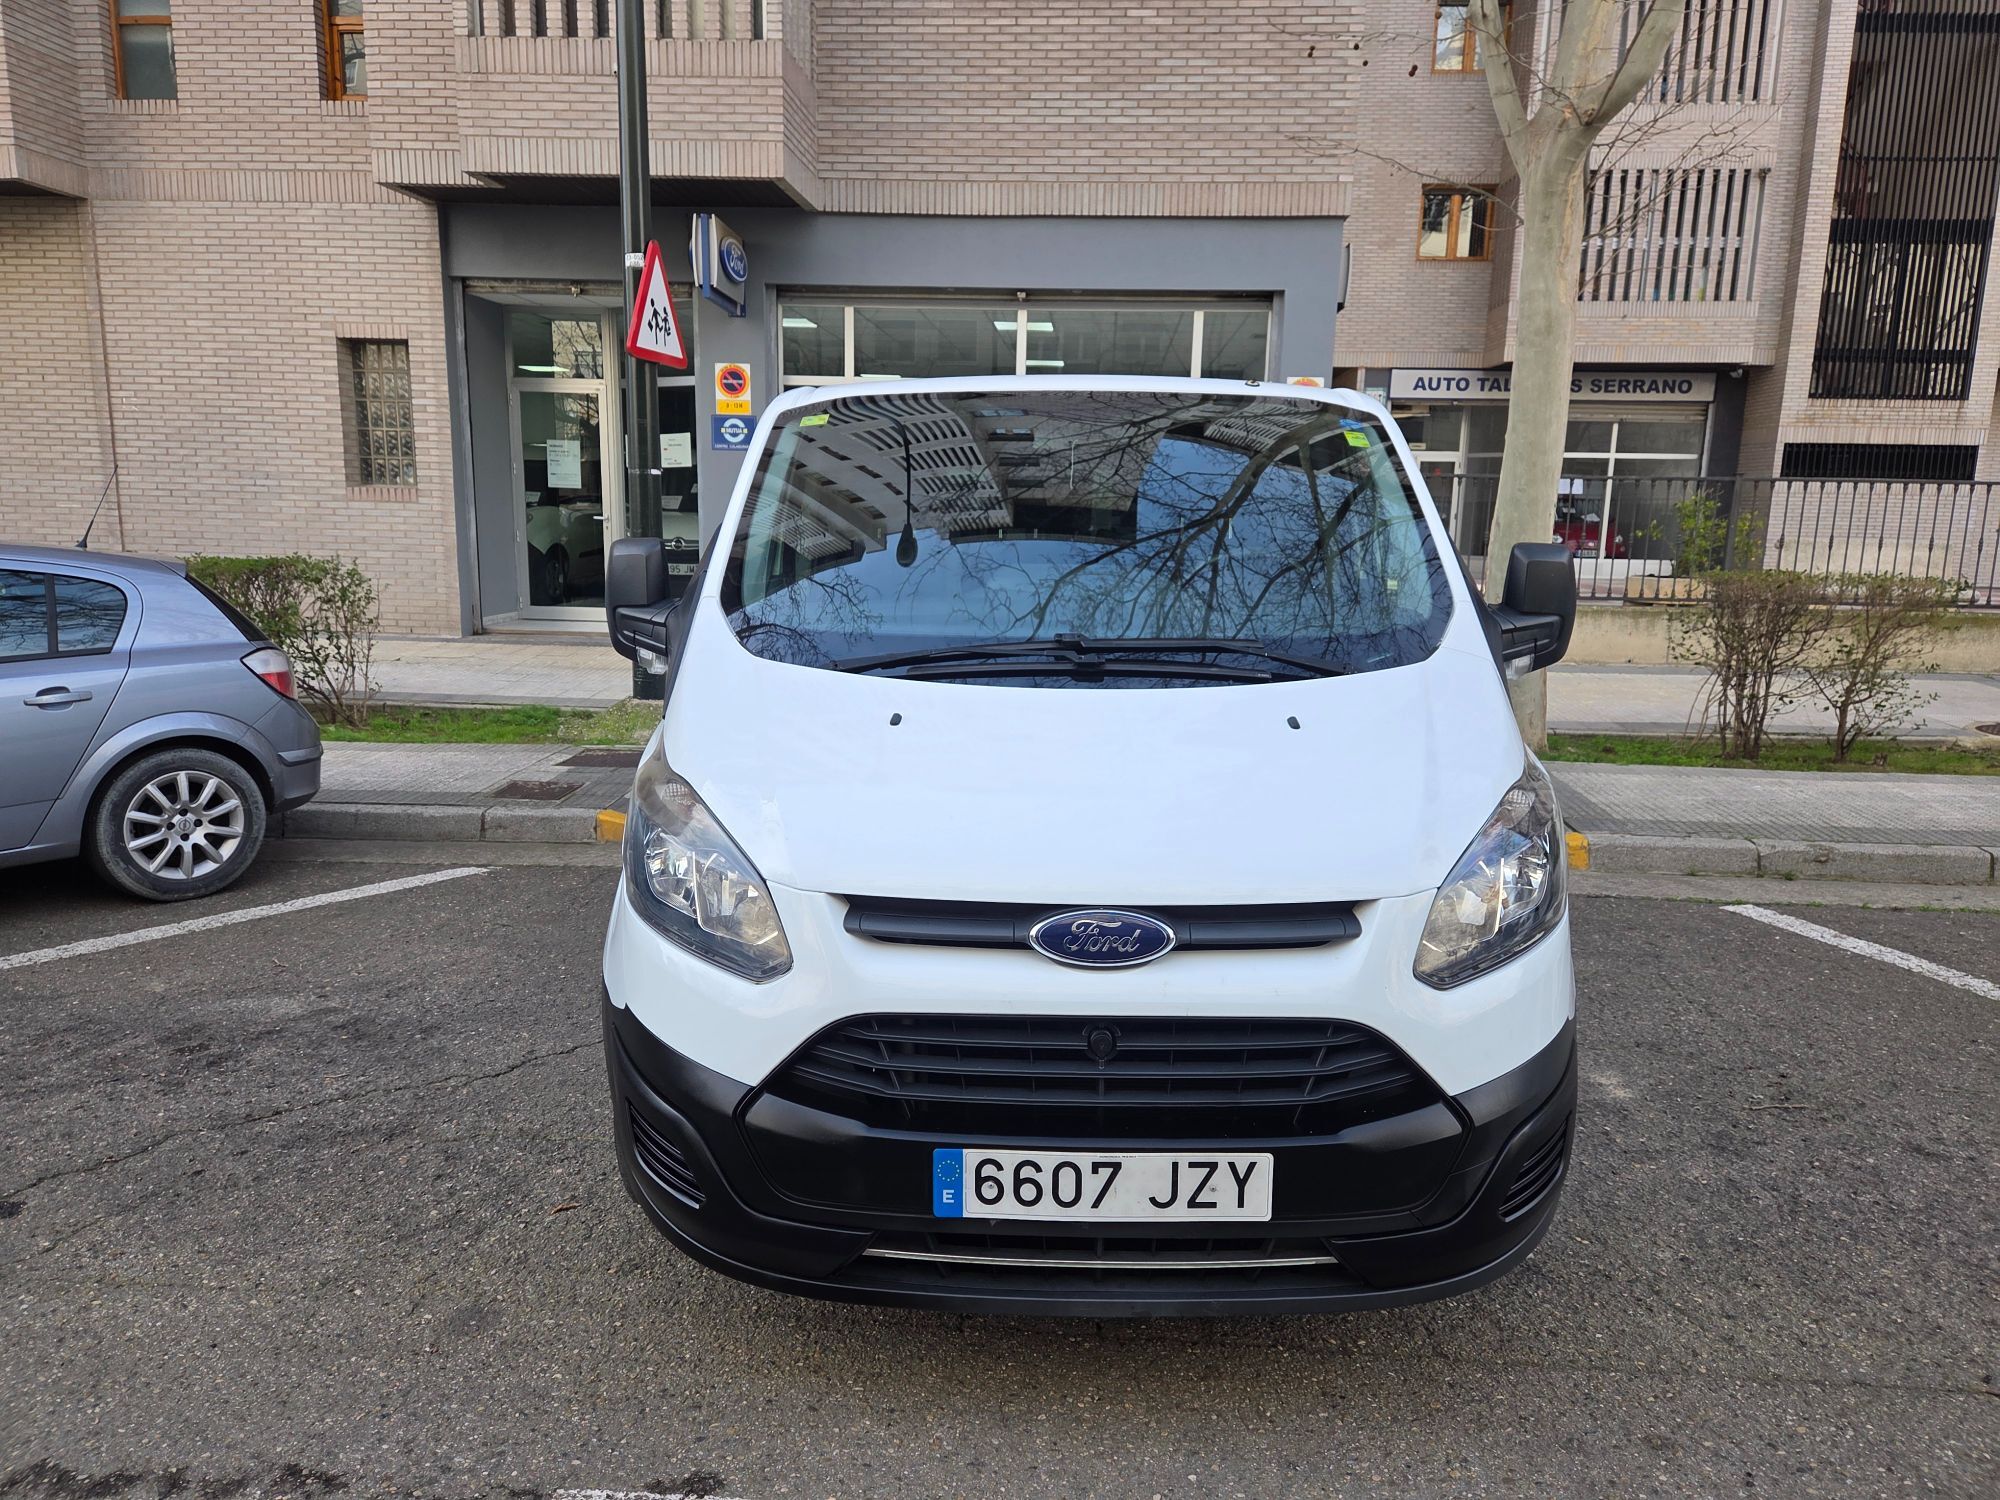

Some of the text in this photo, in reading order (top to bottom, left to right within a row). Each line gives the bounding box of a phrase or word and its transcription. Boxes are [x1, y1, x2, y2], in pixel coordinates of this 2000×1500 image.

[730, 244, 745, 275] Ford
[1413, 376, 1693, 394] AUTO TALS SERRANO
[1063, 919, 1142, 952] Ford
[942, 1189, 954, 1203] E
[974, 1158, 1258, 1210] 6607 JZY
